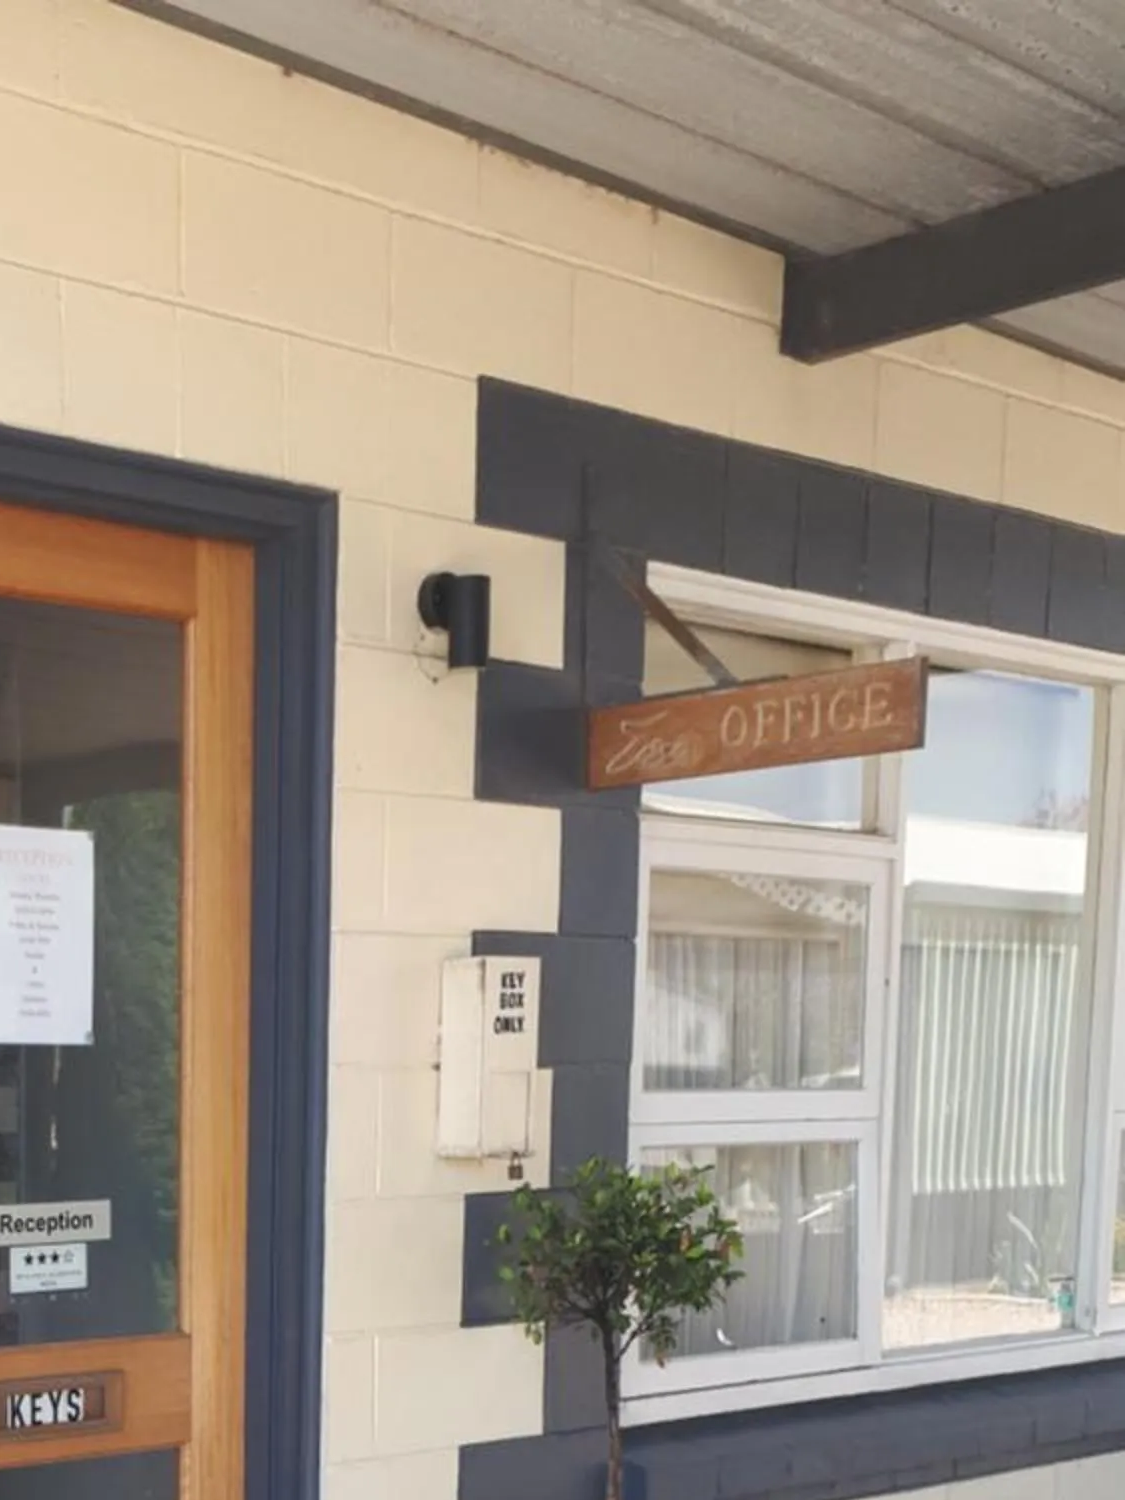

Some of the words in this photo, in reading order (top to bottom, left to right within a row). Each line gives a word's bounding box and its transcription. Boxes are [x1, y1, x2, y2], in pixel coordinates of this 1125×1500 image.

[719, 681, 895, 749] OFFICE
[500, 970, 526, 989] KEY
[499, 991, 525, 1010] BOX
[493, 1015, 525, 1035] ONLY
[8, 1387, 82, 1430] KEYS
